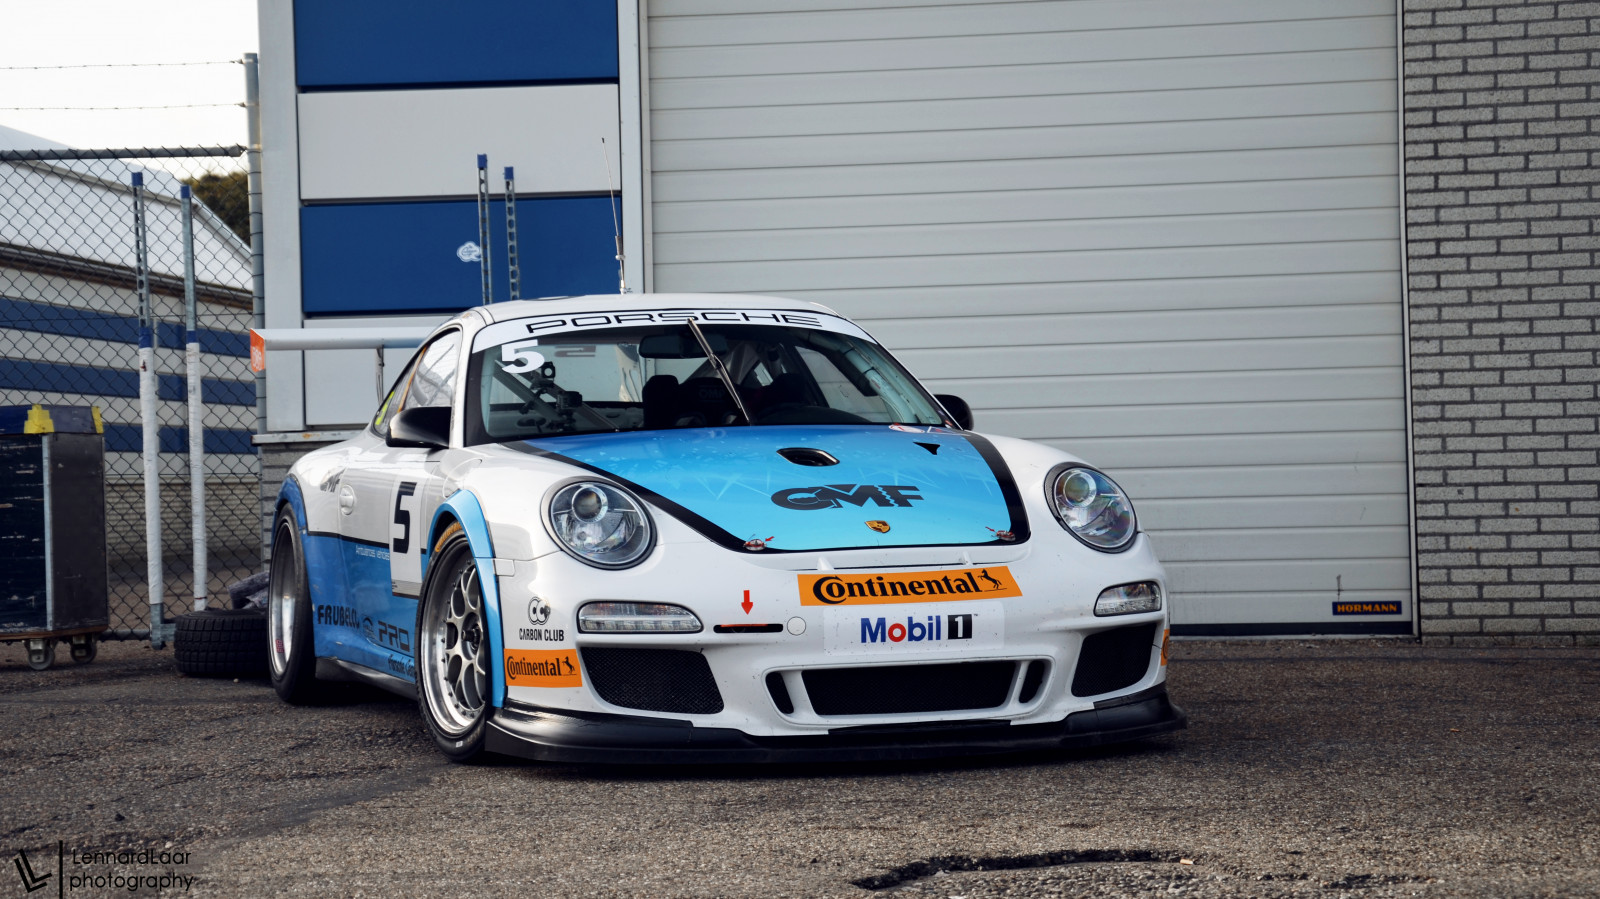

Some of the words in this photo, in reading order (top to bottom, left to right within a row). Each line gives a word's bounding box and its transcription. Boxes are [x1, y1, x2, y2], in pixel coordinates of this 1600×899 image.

[526, 311, 822, 334] PORSCHE
[501, 339, 545, 374] 5
[392, 481, 417, 554] 5
[813, 571, 983, 604] Continental
[378, 620, 410, 652] PRO
[519, 627, 542, 640] CARBON
[544, 629, 564, 641] CLUB
[860, 615, 941, 643] Mobil
[506, 656, 562, 680] Continental
